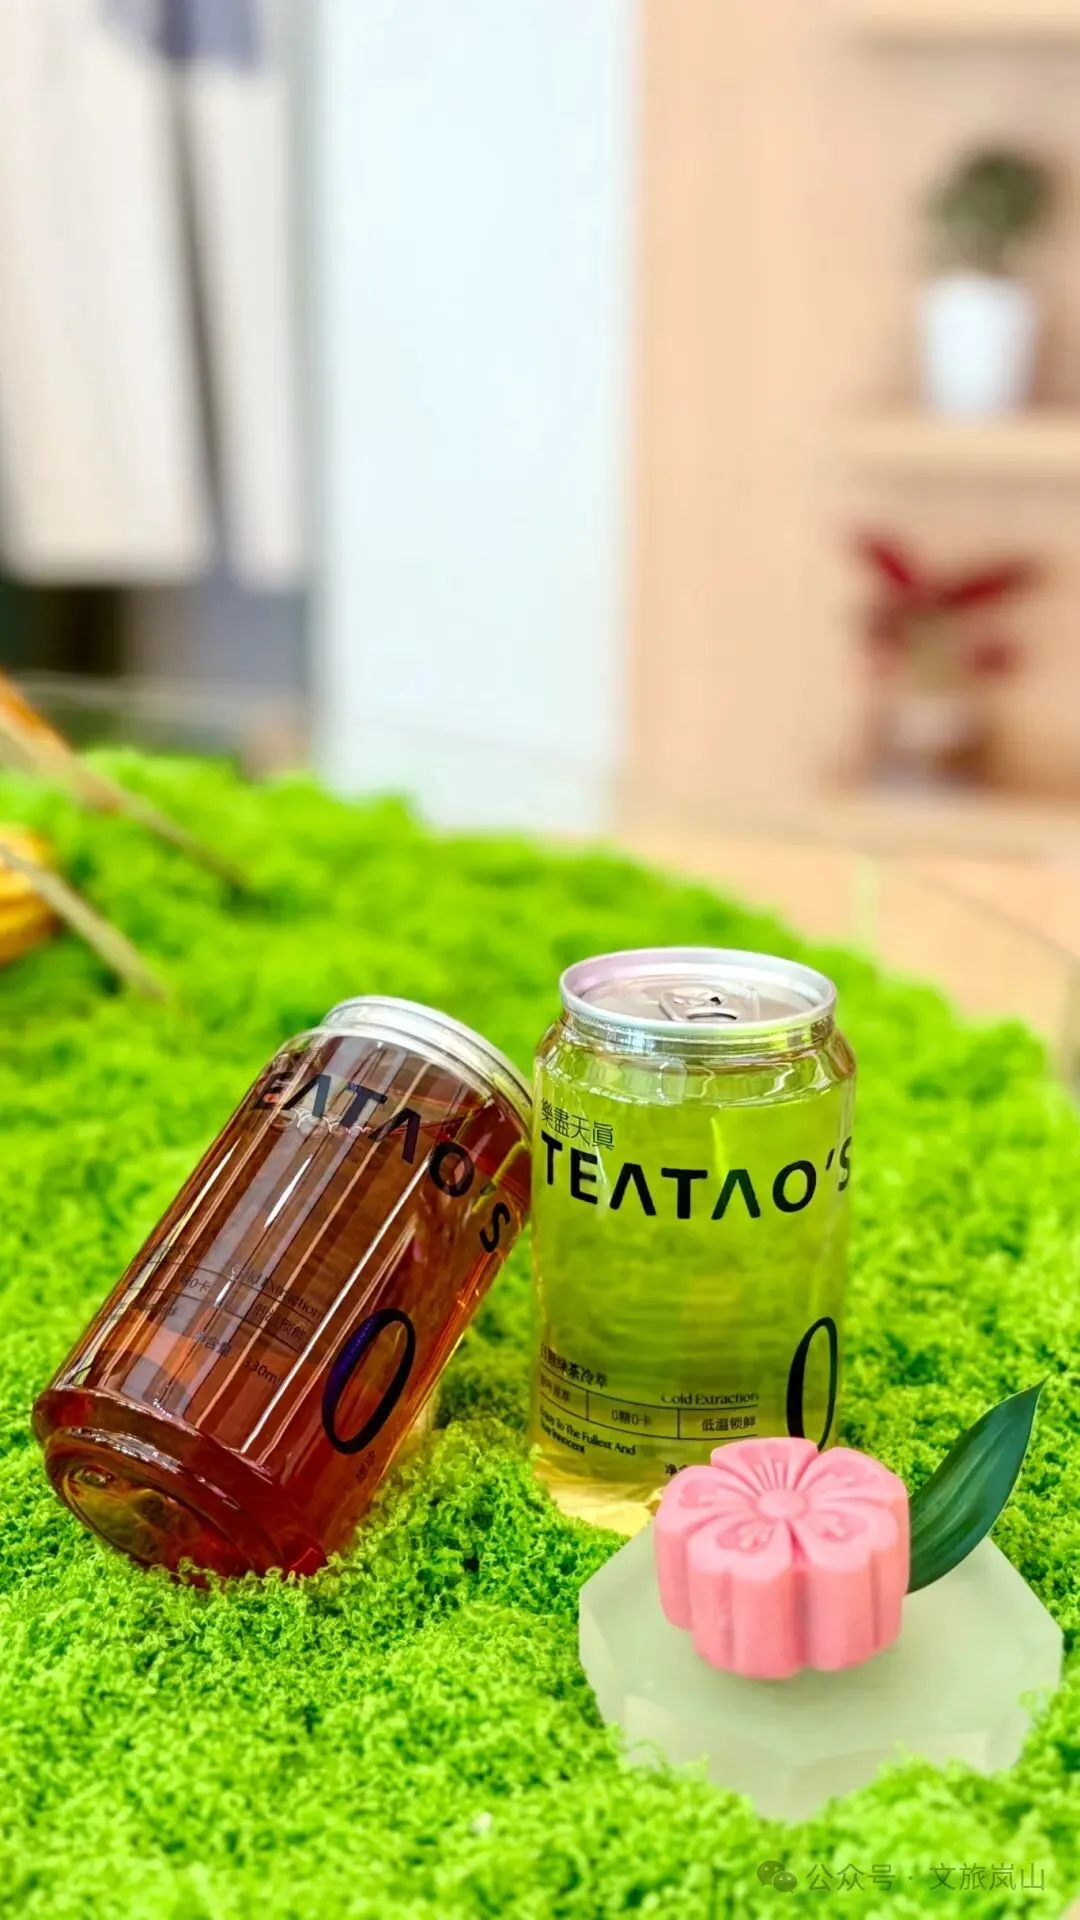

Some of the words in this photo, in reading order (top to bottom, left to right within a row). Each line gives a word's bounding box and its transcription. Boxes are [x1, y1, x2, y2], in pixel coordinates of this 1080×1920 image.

[322, 1308, 416, 1455] 0
[661, 1392, 692, 1406] Cold
[696, 1391, 760, 1406] Extraction
[701, 1414, 756, 1432] 低温锁鲜
[614, 1442, 636, 1456] And
